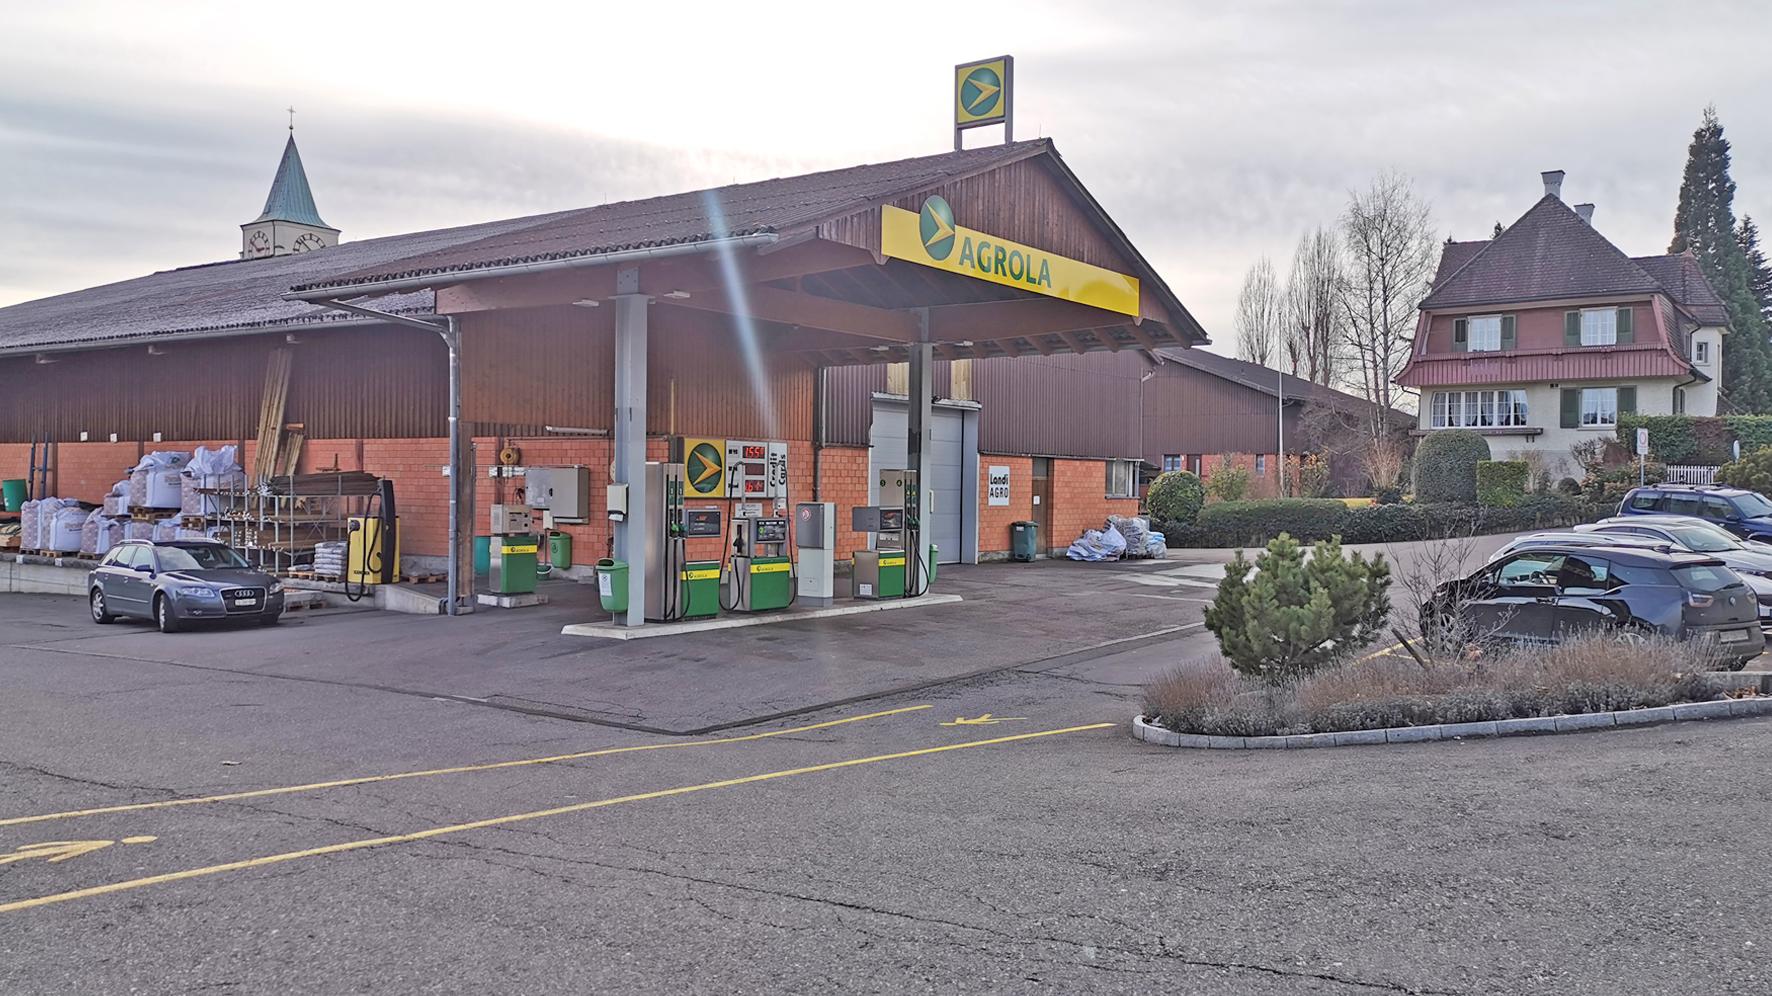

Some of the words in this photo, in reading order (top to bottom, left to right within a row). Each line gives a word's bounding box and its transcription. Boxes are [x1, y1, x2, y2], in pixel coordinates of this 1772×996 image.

[959, 237, 1052, 288] AGROLA
[769, 452, 778, 487] Credit
[990, 473, 1009, 485] Landi
[989, 487, 1009, 498] AGRO
